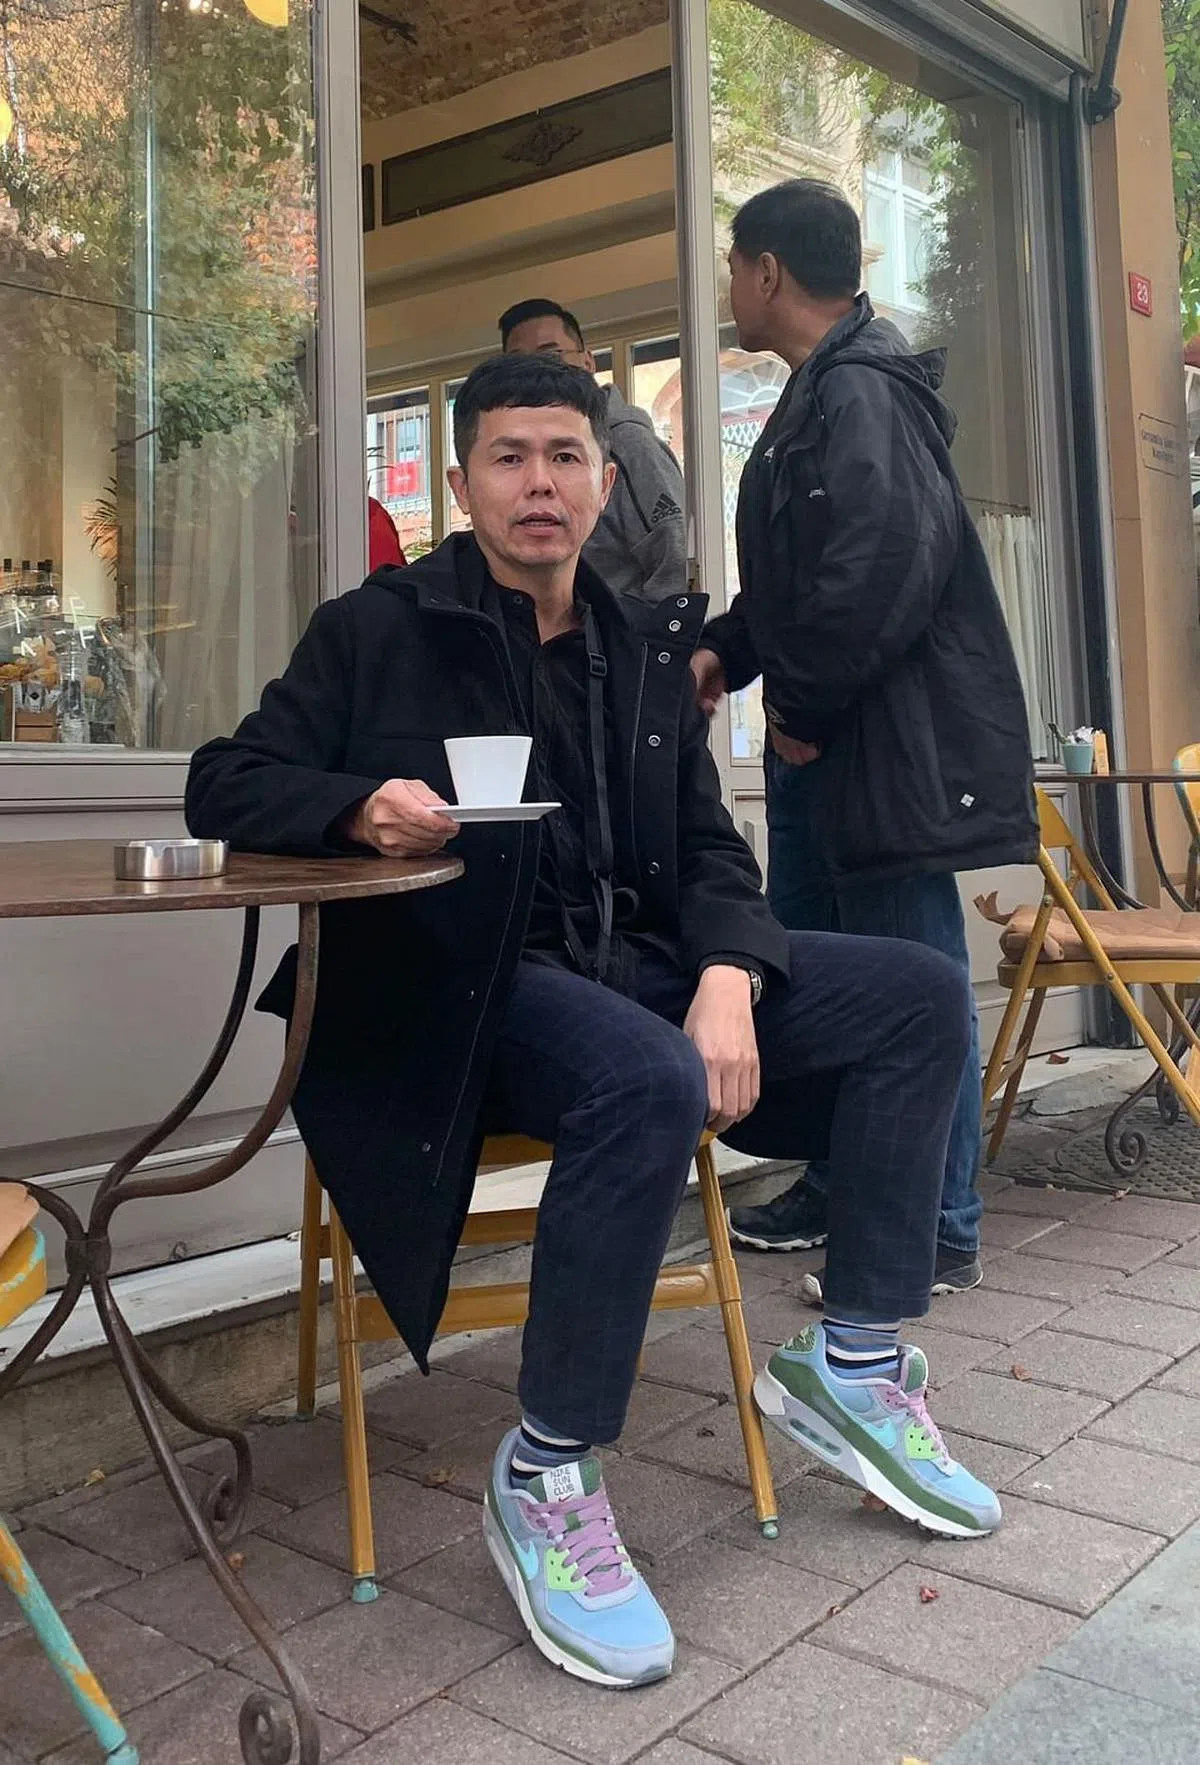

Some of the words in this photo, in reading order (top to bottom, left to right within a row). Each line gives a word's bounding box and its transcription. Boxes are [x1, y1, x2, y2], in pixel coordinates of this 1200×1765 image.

[1137, 282, 1148, 304] 23
[550, 1466, 571, 1479] NIKE
[553, 1475, 571, 1487] SUN
[554, 1483, 575, 1496] CLUB
